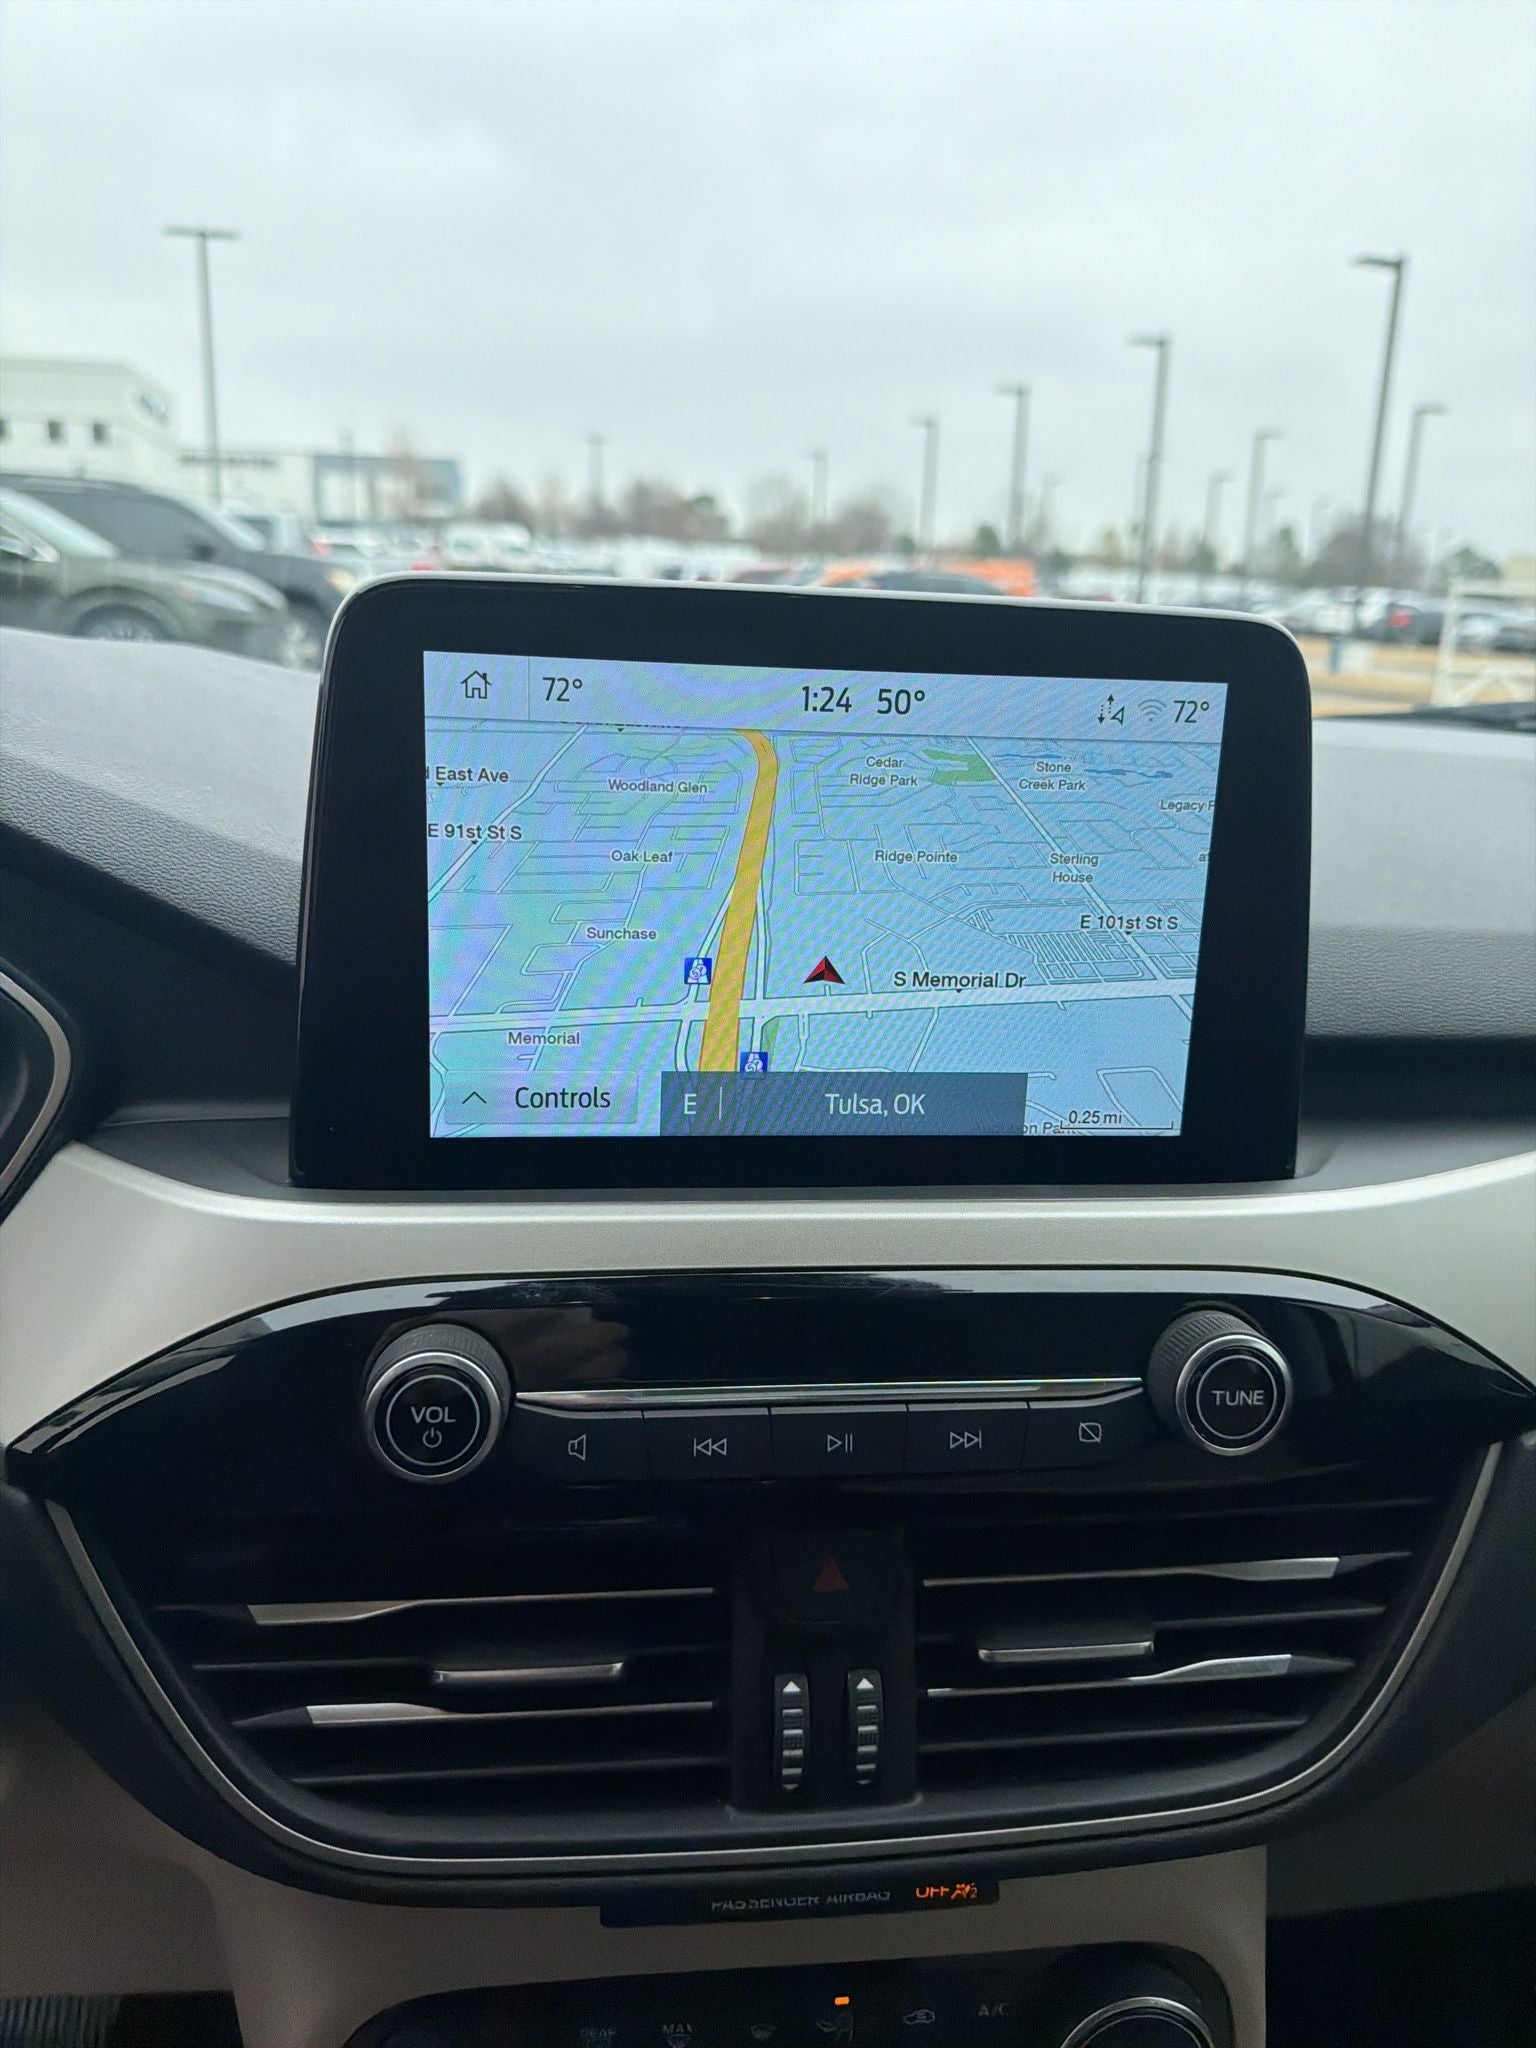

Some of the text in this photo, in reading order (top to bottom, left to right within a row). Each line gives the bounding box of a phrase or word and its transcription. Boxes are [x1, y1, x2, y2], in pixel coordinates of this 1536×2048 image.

[542, 677, 583, 702] 72°
[802, 686, 852, 713] 1:24
[877, 688, 926, 715] 50°
[1173, 700, 1210, 724] 72°
[865, 756, 905, 769] Cedar
[1036, 761, 1071, 774] Stone
[436, 766, 473, 781] East
[478, 768, 509, 782] Ave
[849, 773, 918, 788] Ridge Park
[608, 778, 708, 794] Woodland Glen
[1019, 778, 1086, 791] Creek Park
[1160, 799, 1205, 813] Legacy
[428, 823, 522, 840] E 91st St S
[611, 850, 673, 863] Oak Leaf
[875, 850, 958, 866] Ridge Pointe
[1050, 852, 1099, 867] Sterling
[1052, 871, 1093, 884] House
[1080, 915, 1178, 930] E 101st St S
[586, 927, 657, 940] Sunchase
[894, 971, 1027, 988] S Memorial Dr
[508, 1032, 580, 1046] Memorial
[515, 1086, 611, 1109] Controls
[684, 1093, 697, 1115] E
[825, 1093, 926, 1117] Tulsa, OK
[1068, 1110, 1122, 1124] 0.25 mi
[1211, 1390, 1264, 1406] TUNE
[411, 1406, 456, 1423] VOL
